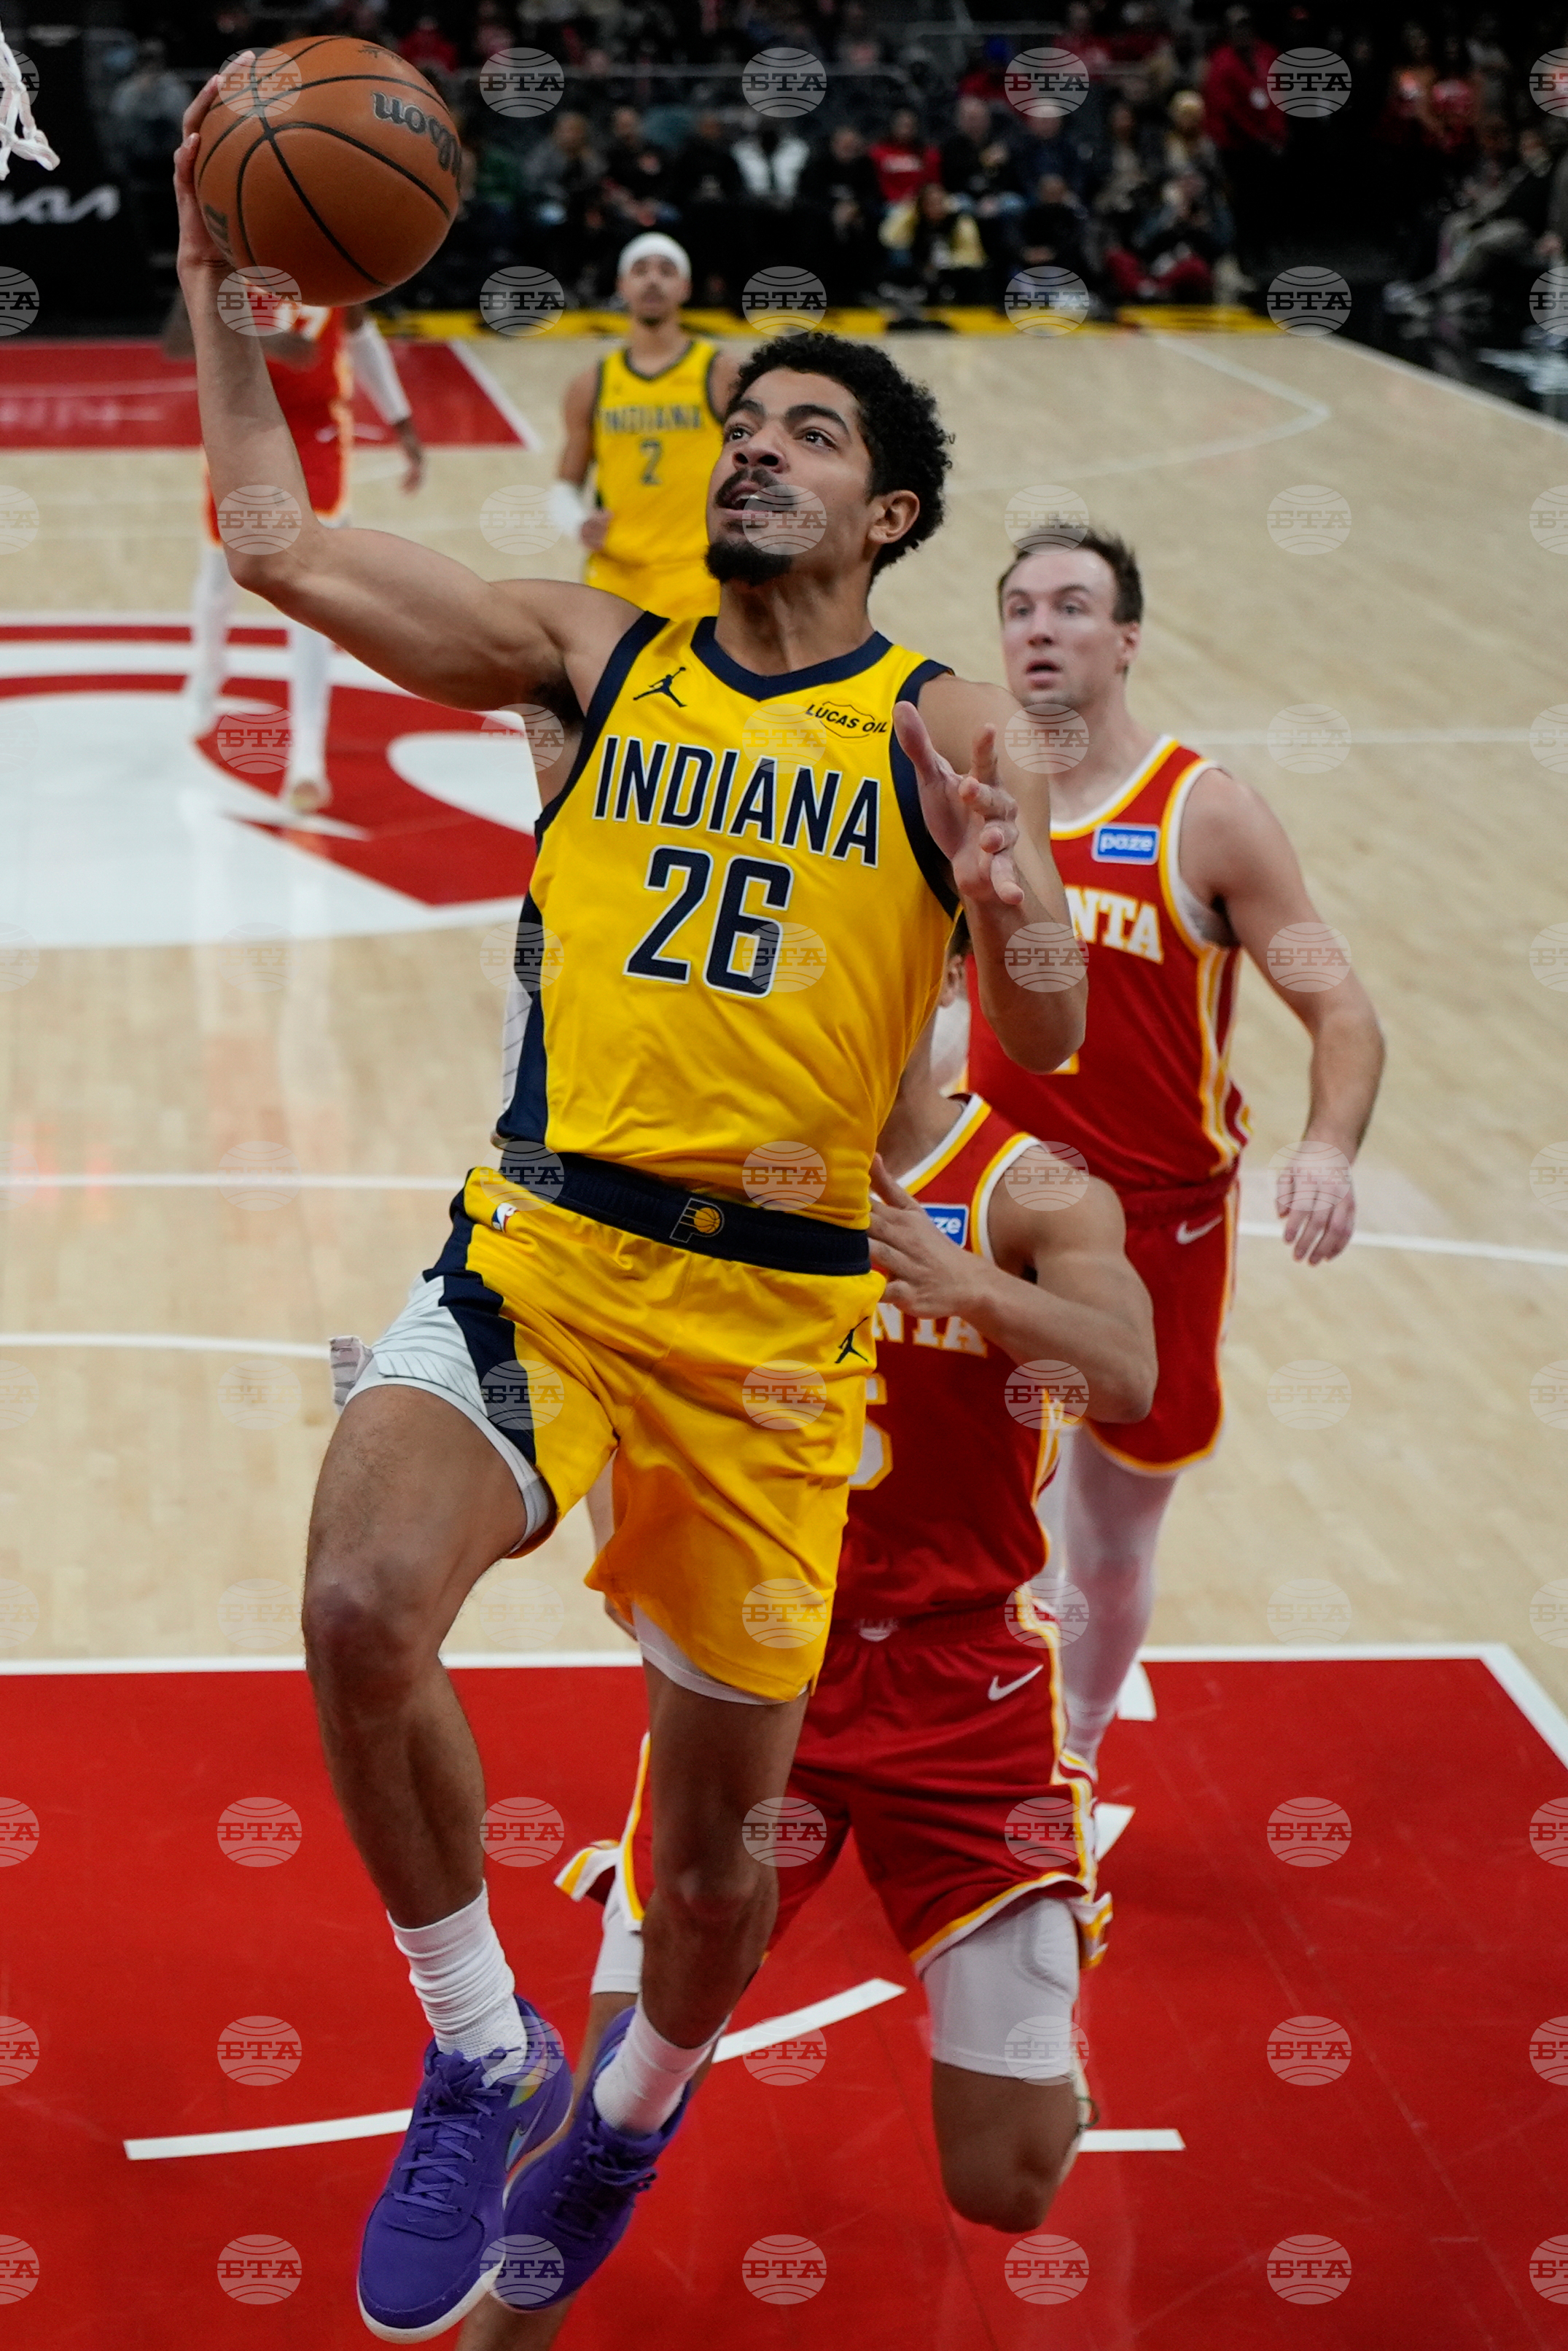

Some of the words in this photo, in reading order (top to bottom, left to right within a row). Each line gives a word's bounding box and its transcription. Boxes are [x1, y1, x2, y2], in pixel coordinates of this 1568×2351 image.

[639, 437, 663, 487] 2
[806, 704, 859, 728] LUCAS
[862, 722, 887, 733] OIL
[592, 735, 881, 870] INDIANA
[1099, 833, 1153, 853] paze
[623, 844, 795, 999] 26
[1064, 885, 1164, 965] NTA
